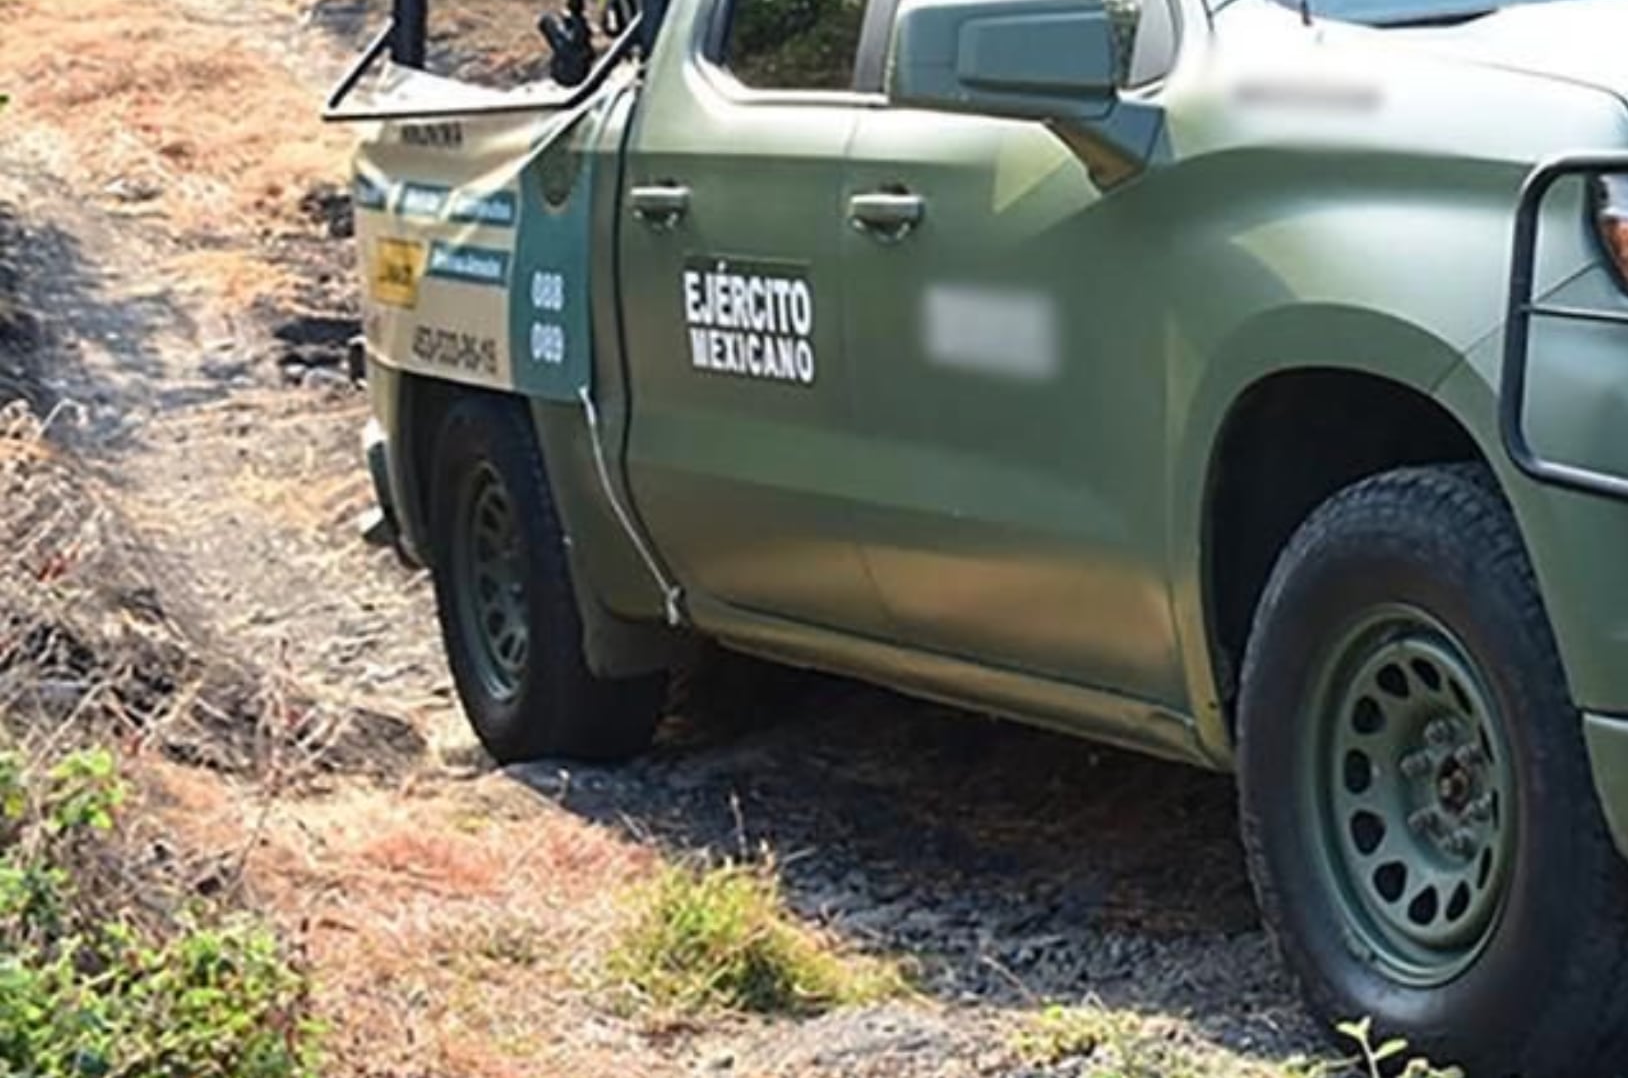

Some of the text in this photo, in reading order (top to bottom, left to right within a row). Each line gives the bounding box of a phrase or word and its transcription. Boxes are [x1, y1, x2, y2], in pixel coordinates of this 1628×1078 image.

[531, 270, 565, 312] 088
[684, 260, 811, 336] EJÉRCITO
[689, 327, 814, 383] MEXICANO
